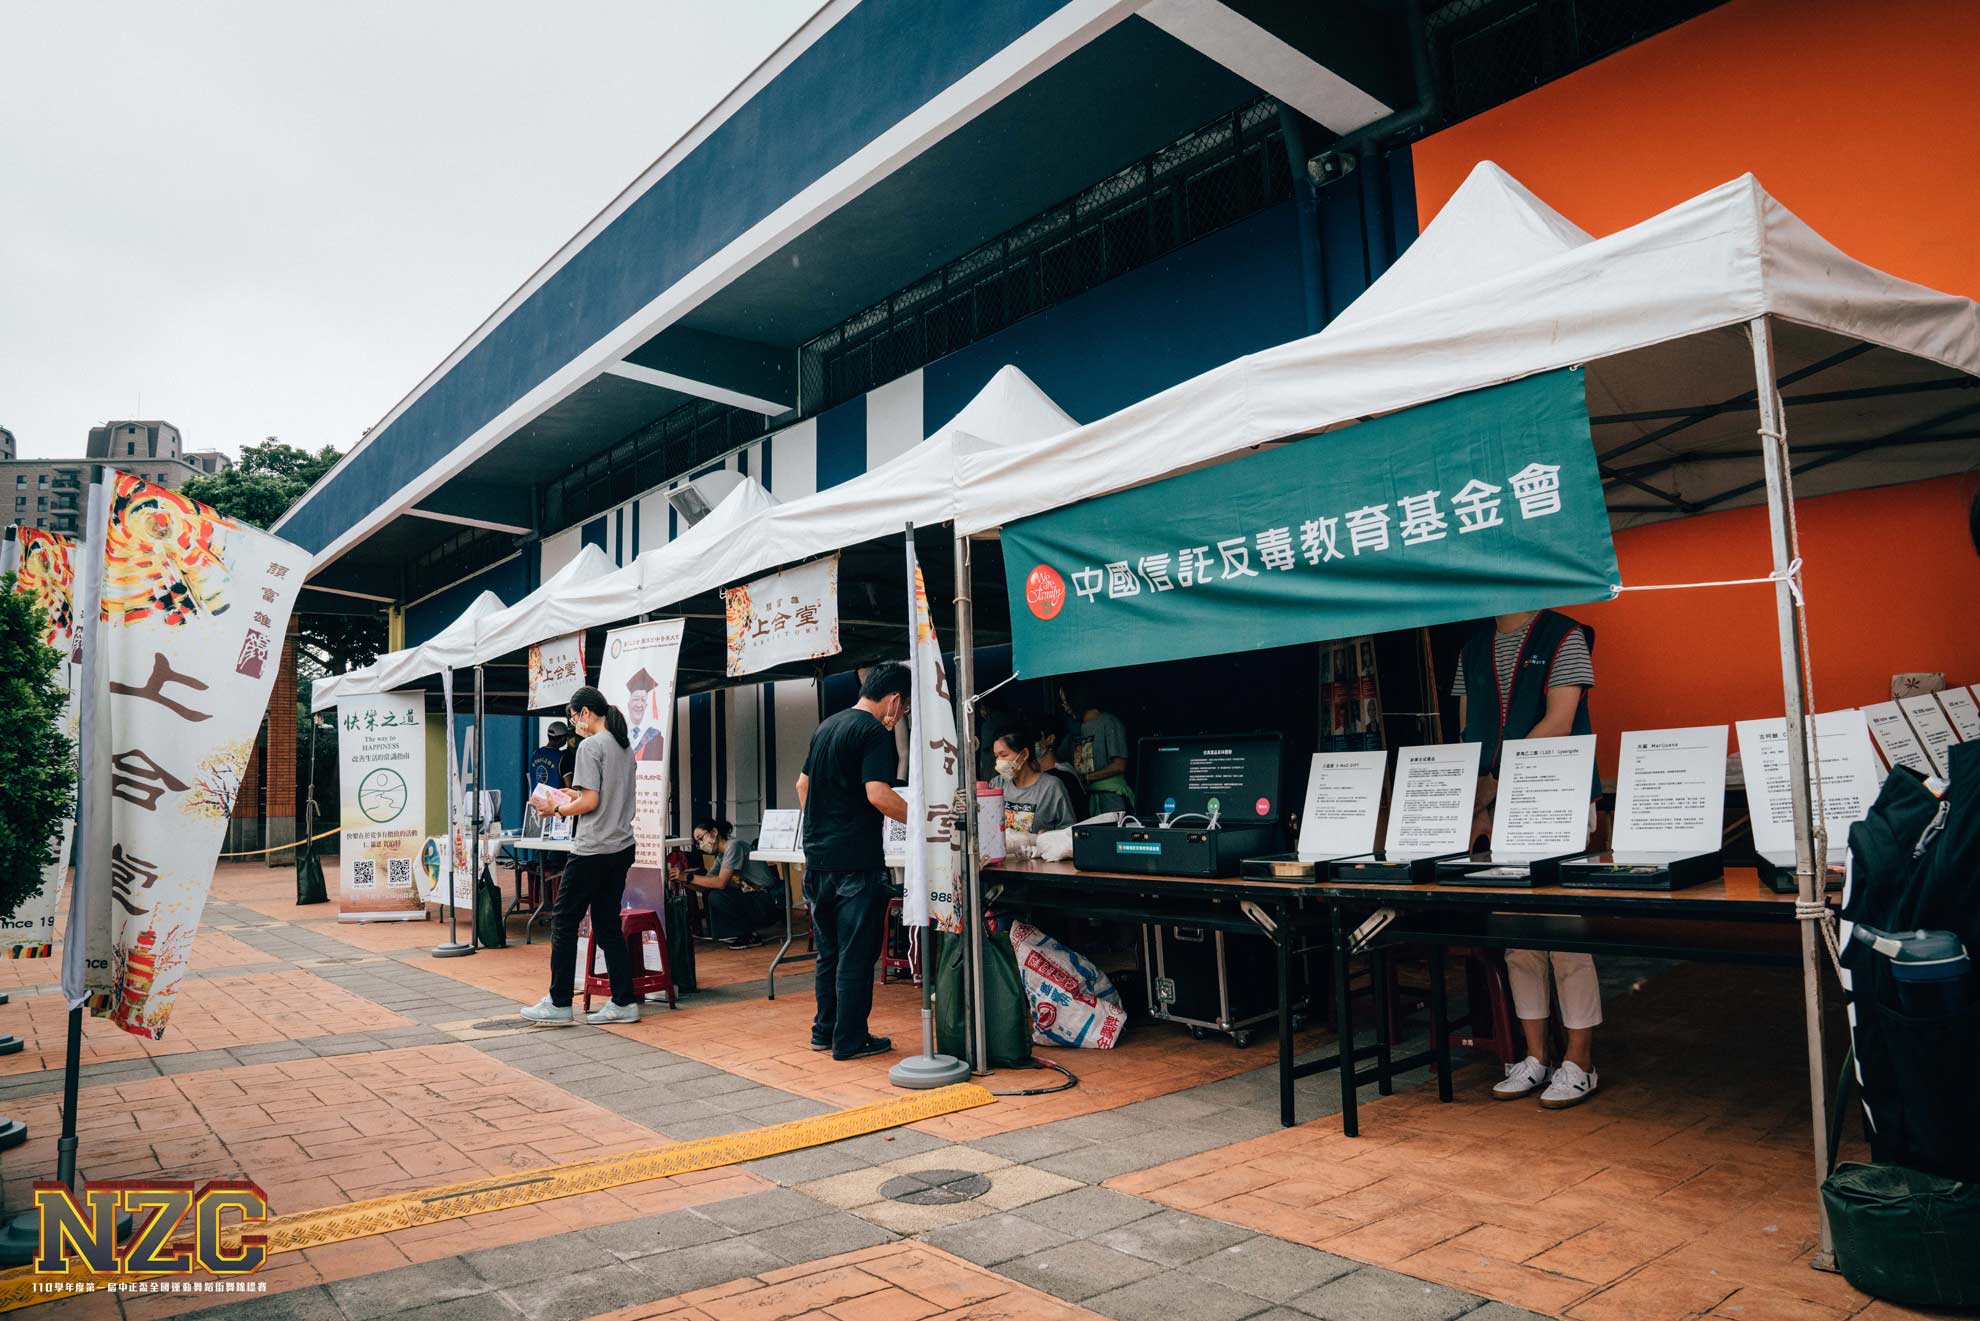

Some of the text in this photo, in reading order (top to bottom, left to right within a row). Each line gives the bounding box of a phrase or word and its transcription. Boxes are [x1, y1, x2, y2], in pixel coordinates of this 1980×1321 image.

[1071, 462, 1562, 603] 中國信託反毒教育基金會
[1031, 572, 1050, 585] We
[254, 562, 290, 628] 顏富雄
[752, 604, 819, 639] 上合堂
[344, 708, 420, 732] 快樂之道
[362, 743, 400, 751] HAPPINESS
